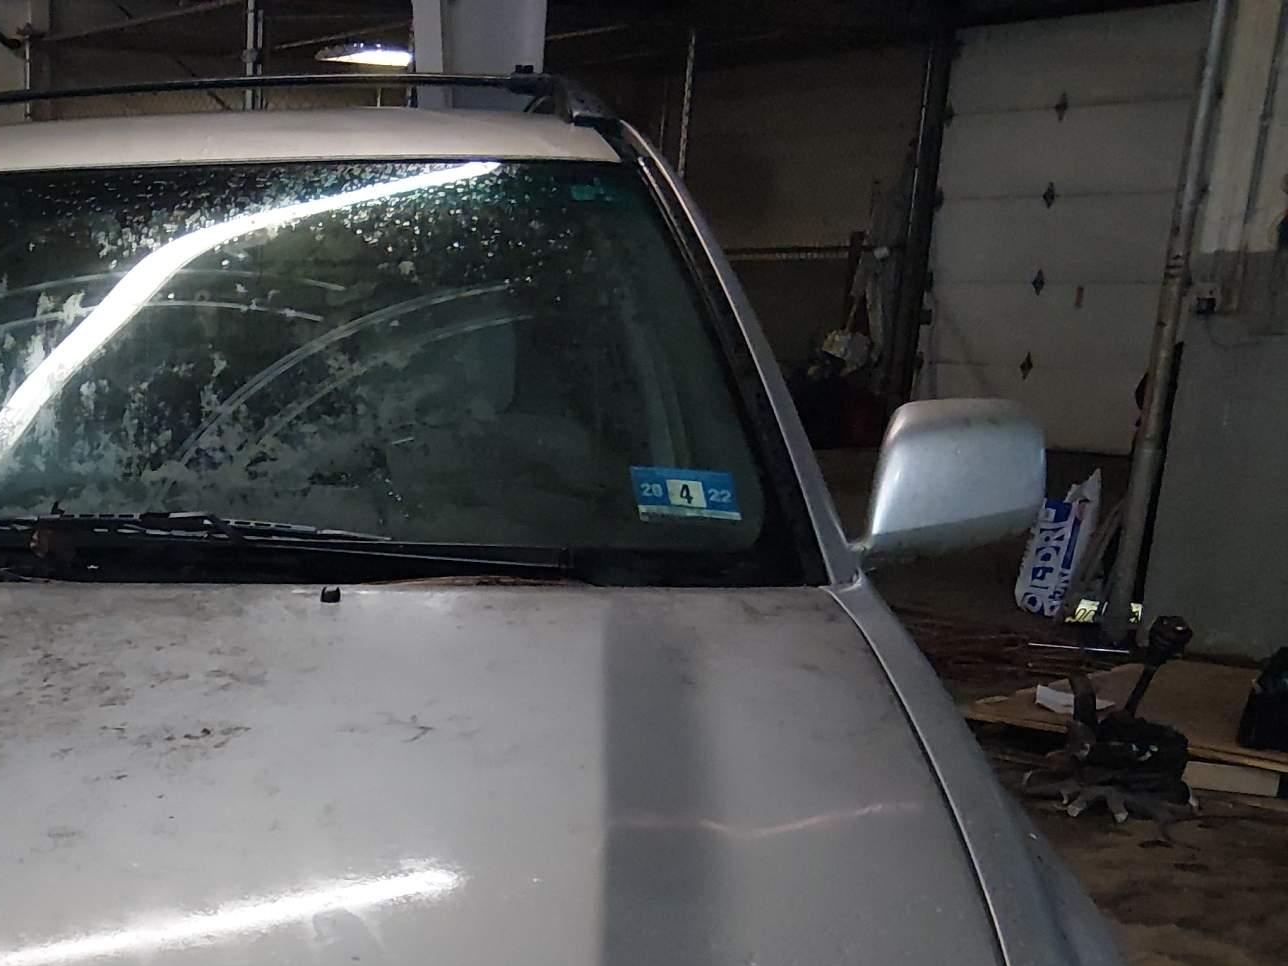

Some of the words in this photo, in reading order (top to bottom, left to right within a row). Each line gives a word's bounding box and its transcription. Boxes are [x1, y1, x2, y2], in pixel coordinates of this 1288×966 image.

[639, 483, 664, 498] 20
[679, 483, 694, 505] 4
[707, 488, 732, 503] 22
